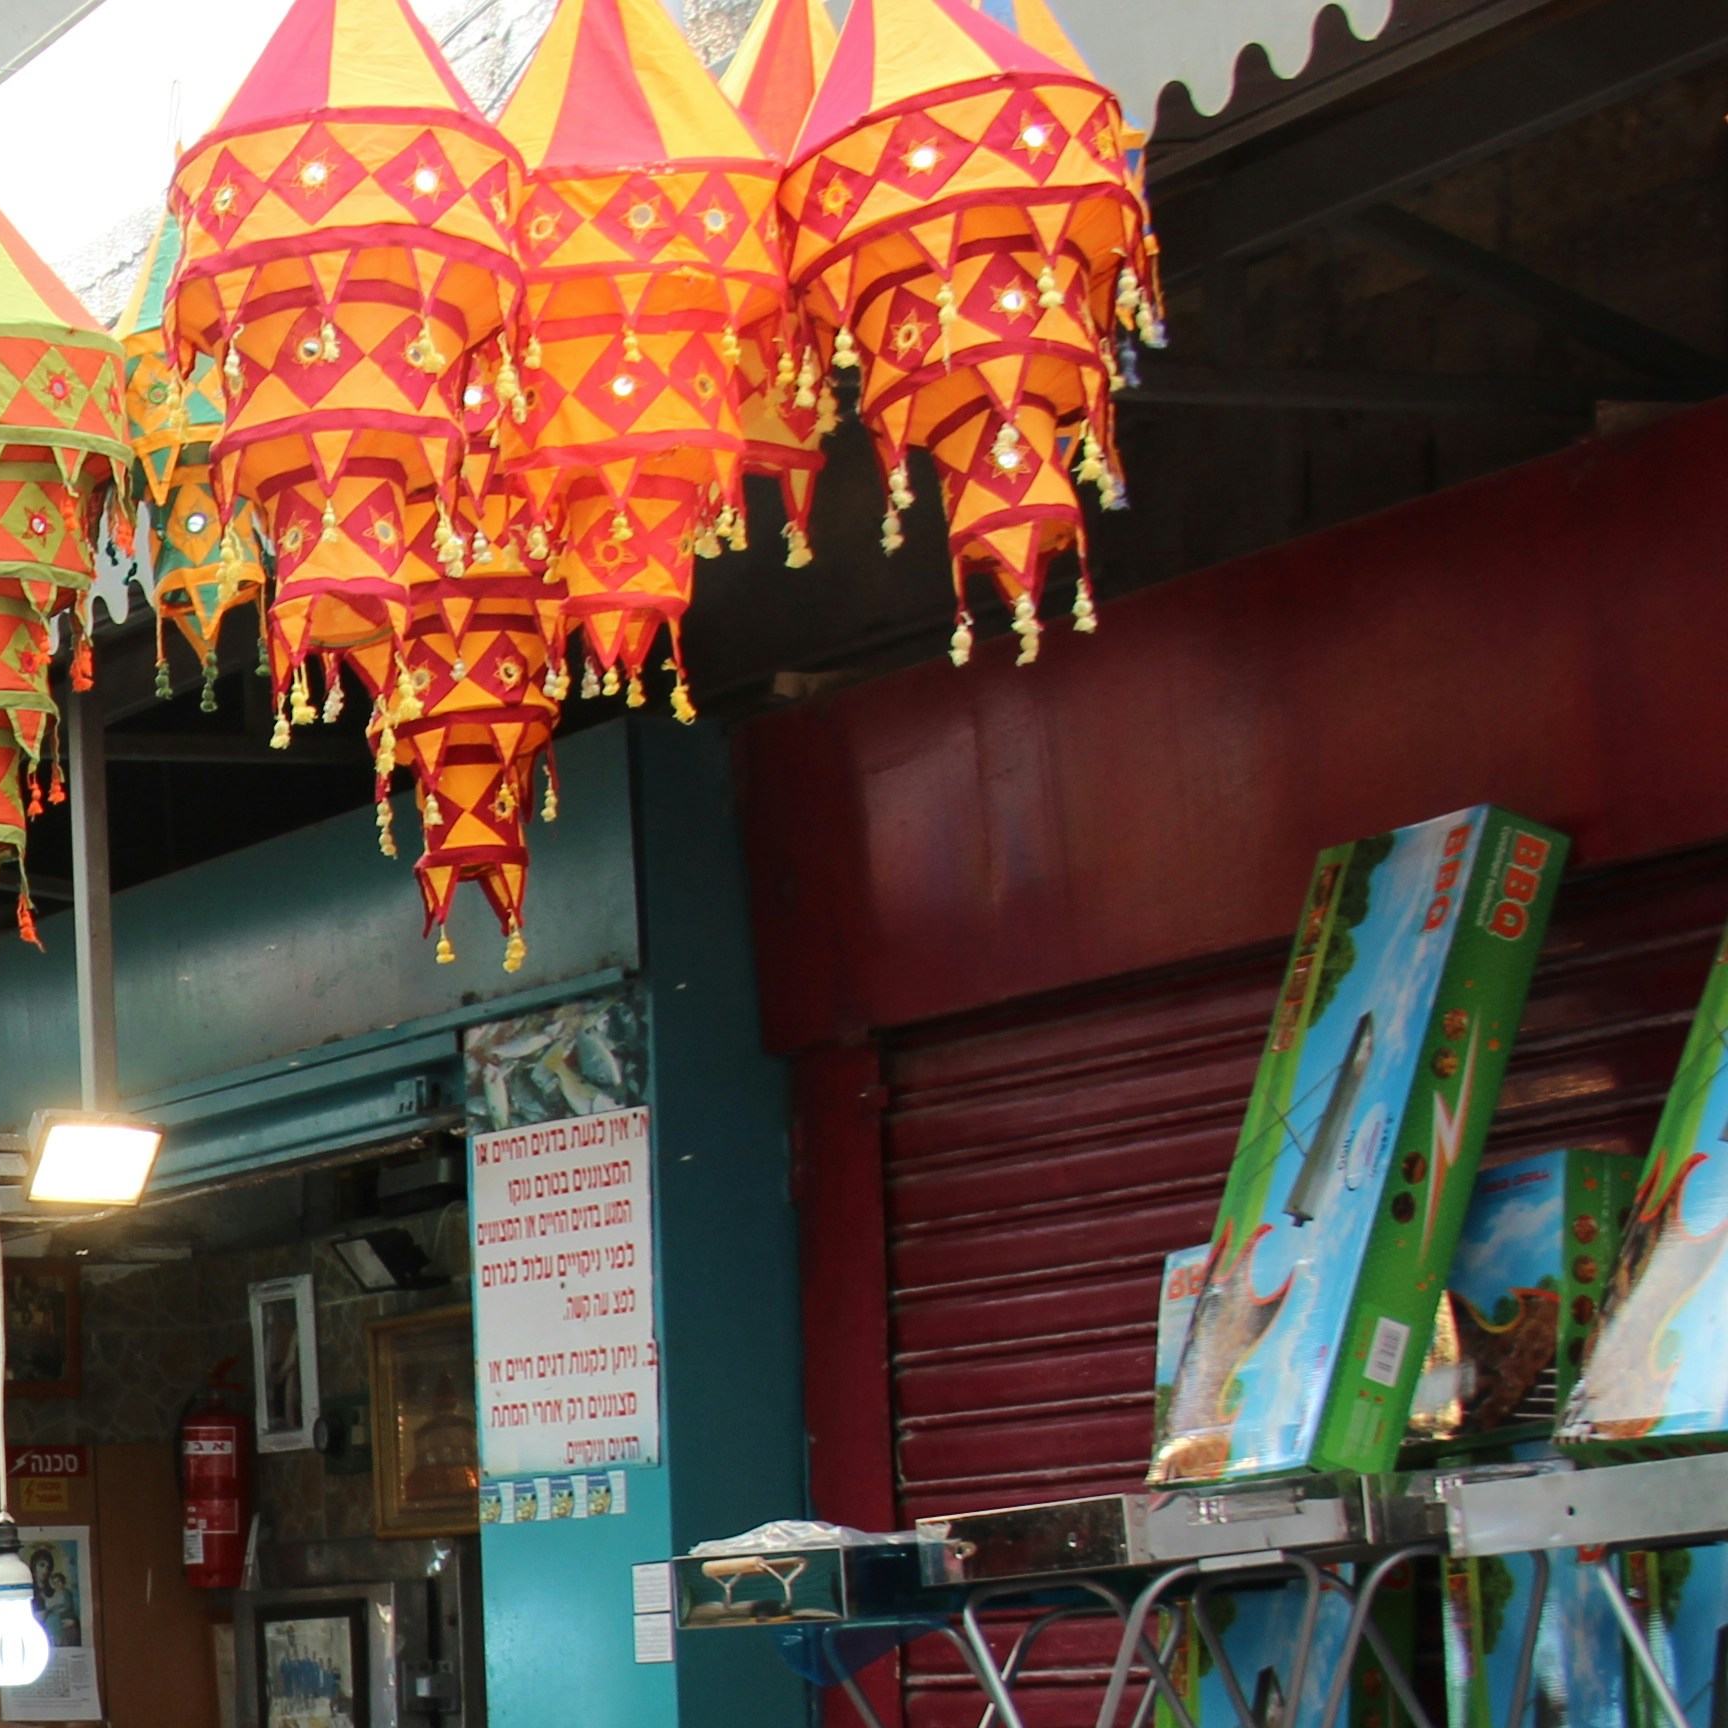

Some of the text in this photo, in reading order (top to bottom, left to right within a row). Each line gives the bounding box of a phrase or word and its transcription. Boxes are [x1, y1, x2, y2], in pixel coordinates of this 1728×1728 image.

[1420, 823, 1473, 932] BBQ
[1487, 830, 1551, 941] BBQ
[531, 1127, 566, 1156] בדגים
[570, 1118, 605, 1149] לגעת
[609, 1116, 630, 1147] אין
[492, 1135, 527, 1163] החיים
[535, 1170, 569, 1198] בטרם
[573, 1159, 632, 1192] המצוננים
[524, 1214, 537, 1239] או
[538, 1209, 569, 1236] החיים
[571, 1203, 602, 1231] בדגים
[604, 1199, 632, 1226] המגע
[482, 1240, 635, 1288] לפני ניקויים עלול לגרום
[1168, 1264, 1205, 1301] BB
[488, 1360, 502, 1383] או
[505, 1356, 533, 1381] חיים
[537, 1352, 564, 1379] דגים
[568, 1345, 606, 1377] לקנות
[611, 1344, 637, 1375] ניתן
[532, 1399, 563, 1424] אחרי
[567, 1397, 585, 1424] רק
[588, 1391, 637, 1419] מצוננים
[30, 1452, 79, 1474] סכנה
